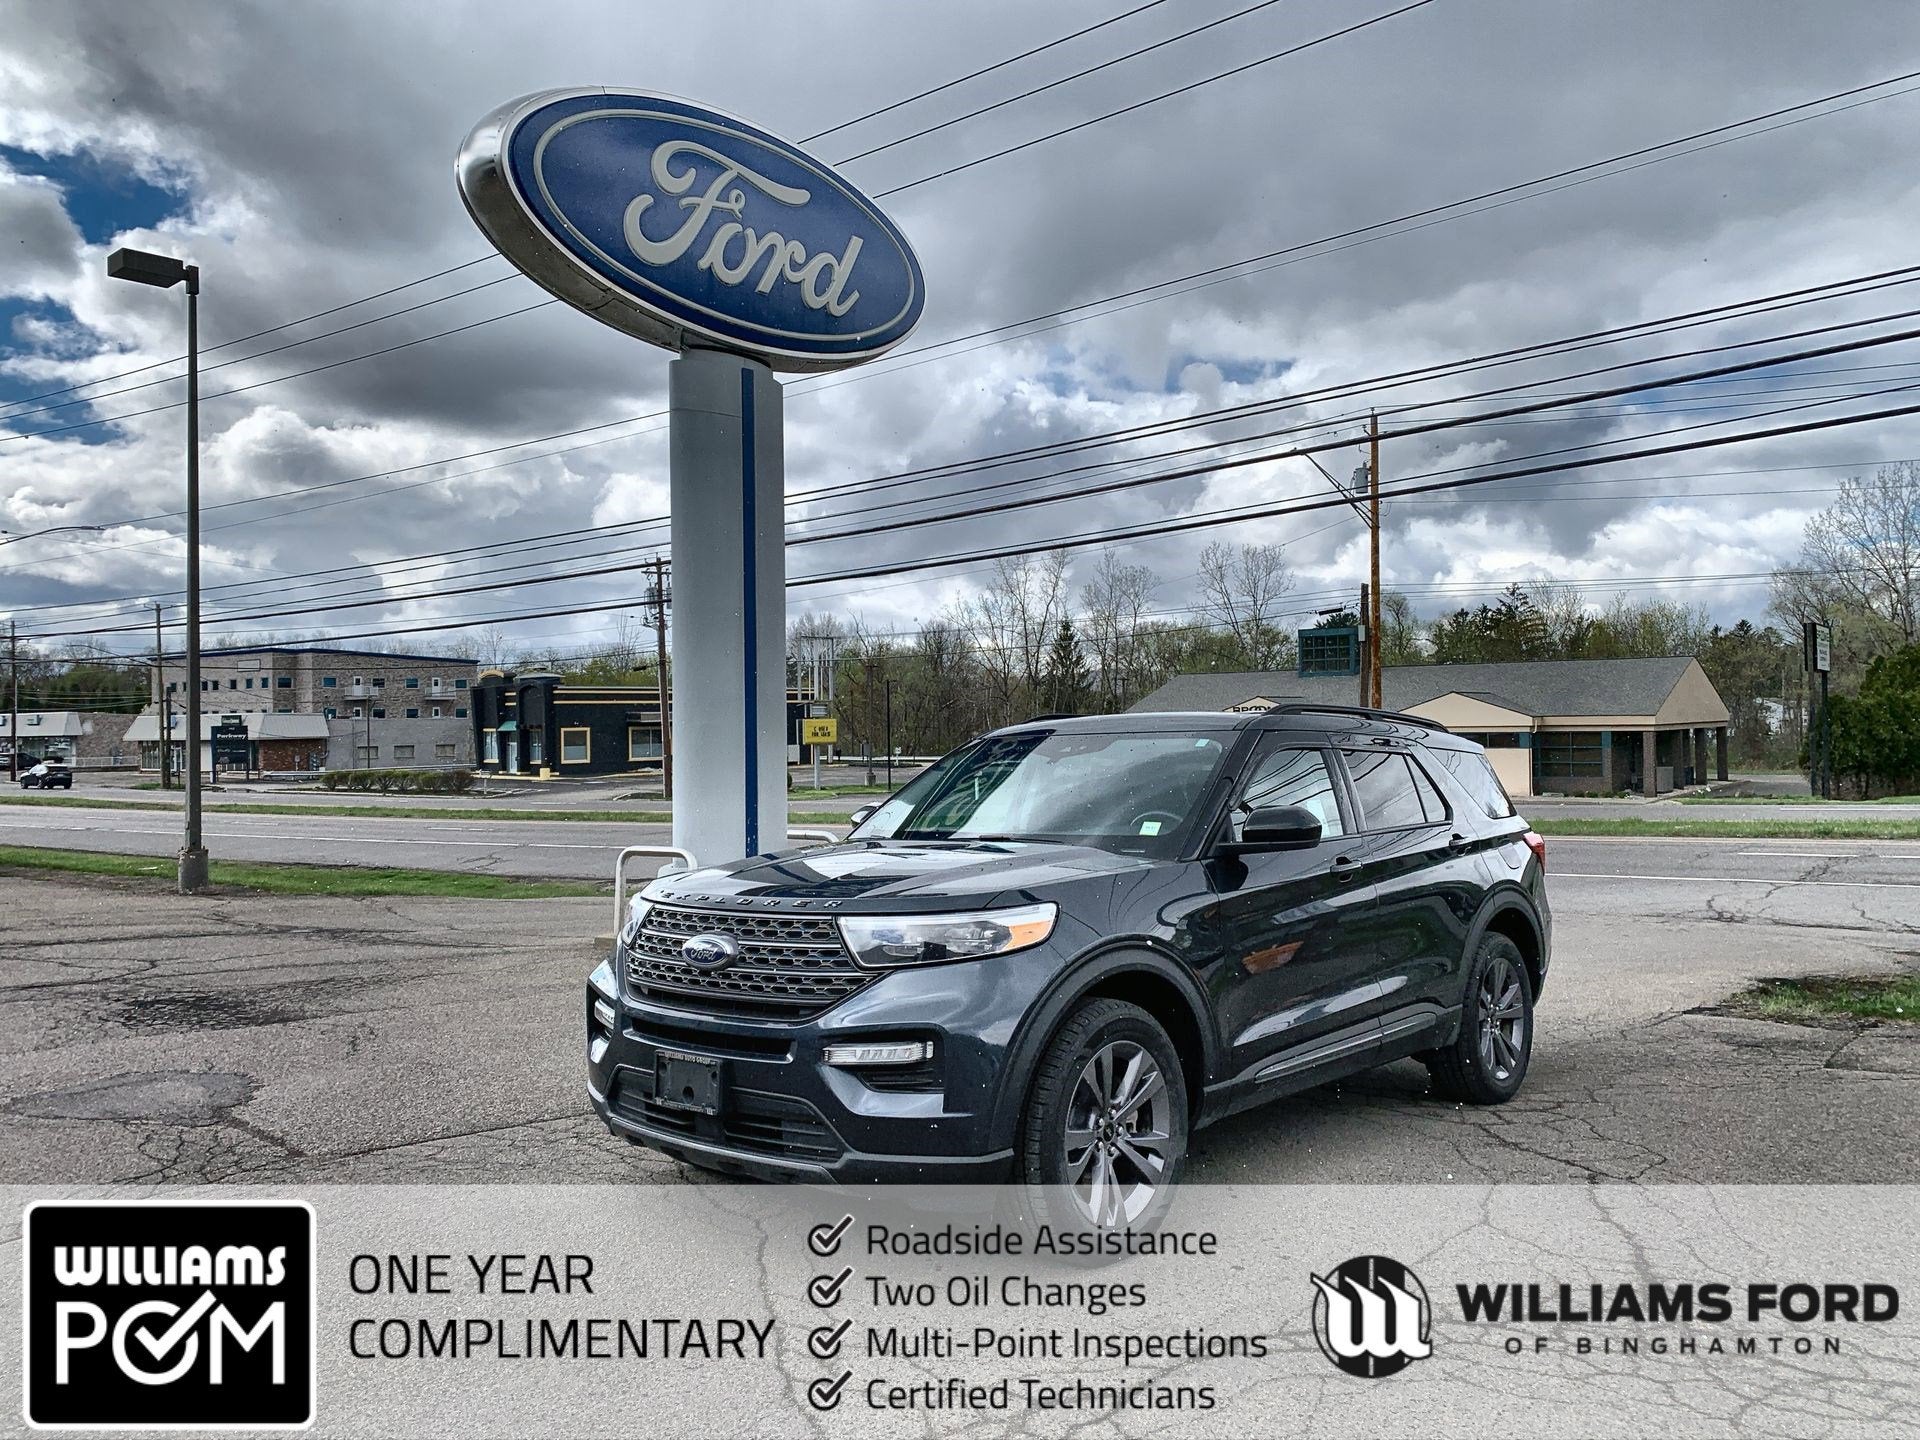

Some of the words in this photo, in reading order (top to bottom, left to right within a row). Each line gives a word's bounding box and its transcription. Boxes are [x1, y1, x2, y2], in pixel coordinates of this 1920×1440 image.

[623, 140, 864, 317] Ford
[660, 889, 843, 908] EXPLORER
[690, 943, 717, 962] Ford
